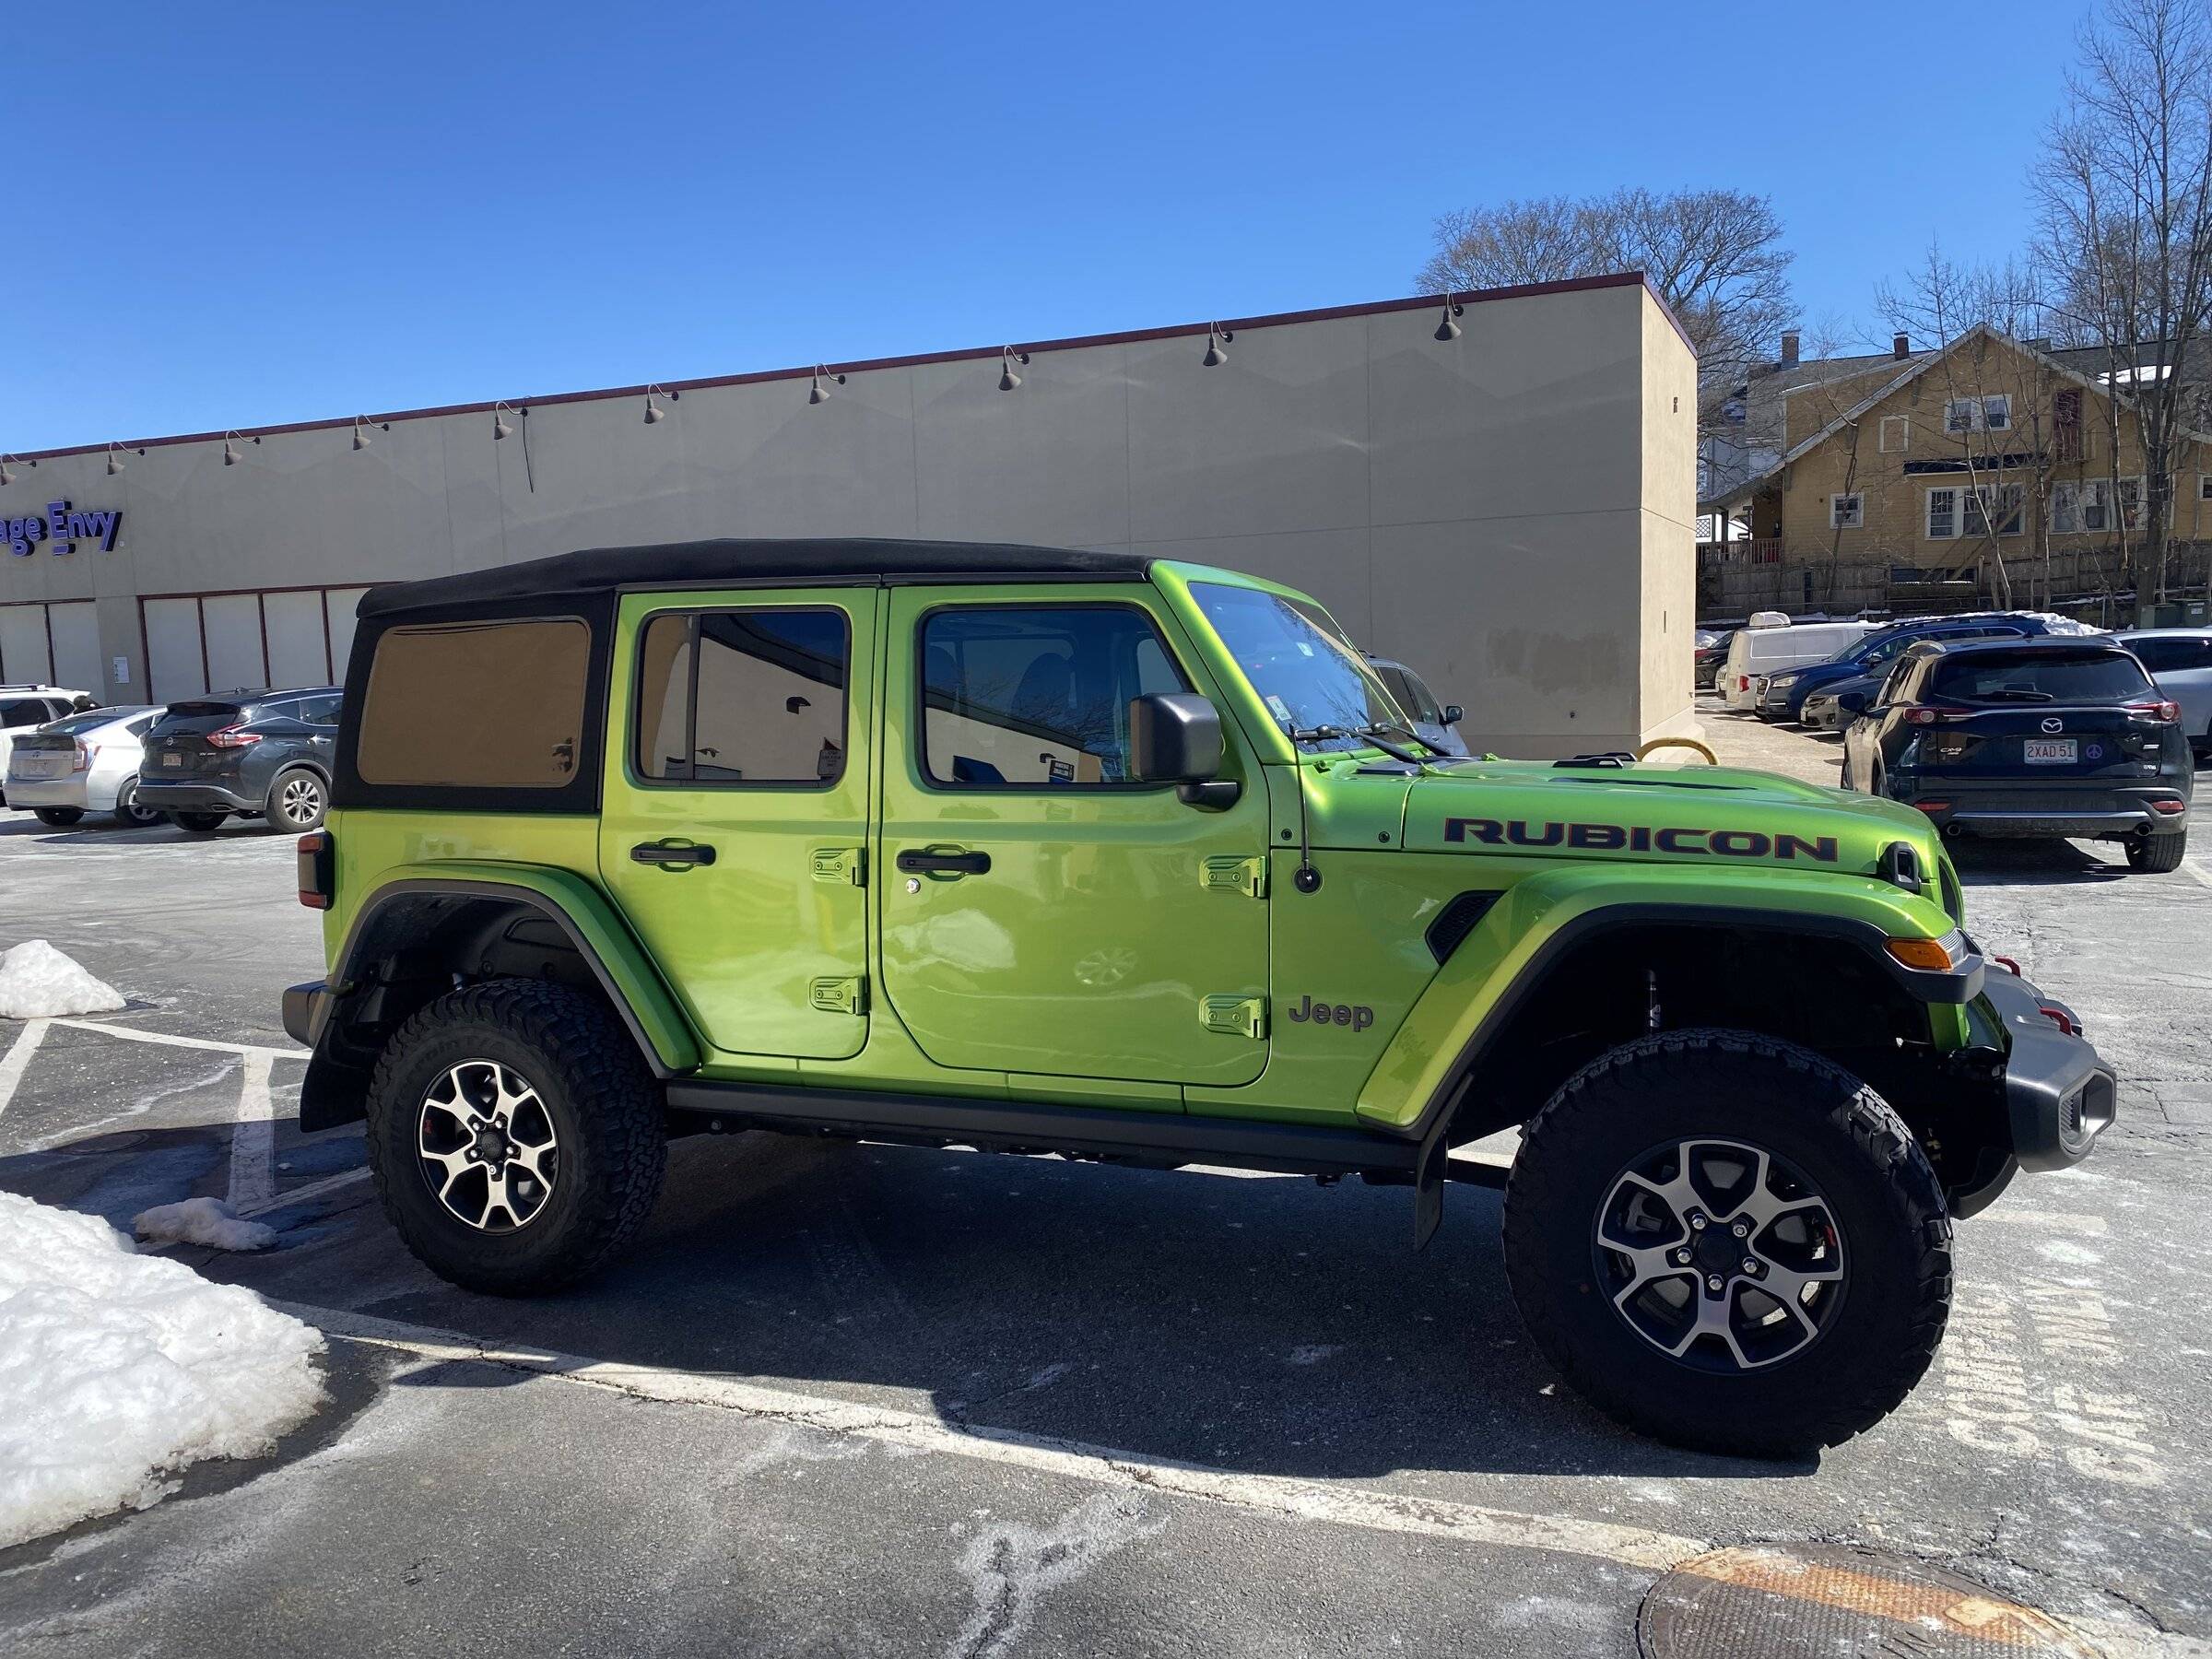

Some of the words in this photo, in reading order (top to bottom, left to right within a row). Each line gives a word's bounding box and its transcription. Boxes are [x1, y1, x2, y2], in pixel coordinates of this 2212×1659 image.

[46, 500, 116, 554] Envy
[2027, 745, 2056, 759] 2XAD
[2059, 745, 2074, 758] 51
[1443, 817, 1839, 863] RUBICON
[1288, 995, 1373, 1033] Jeep
